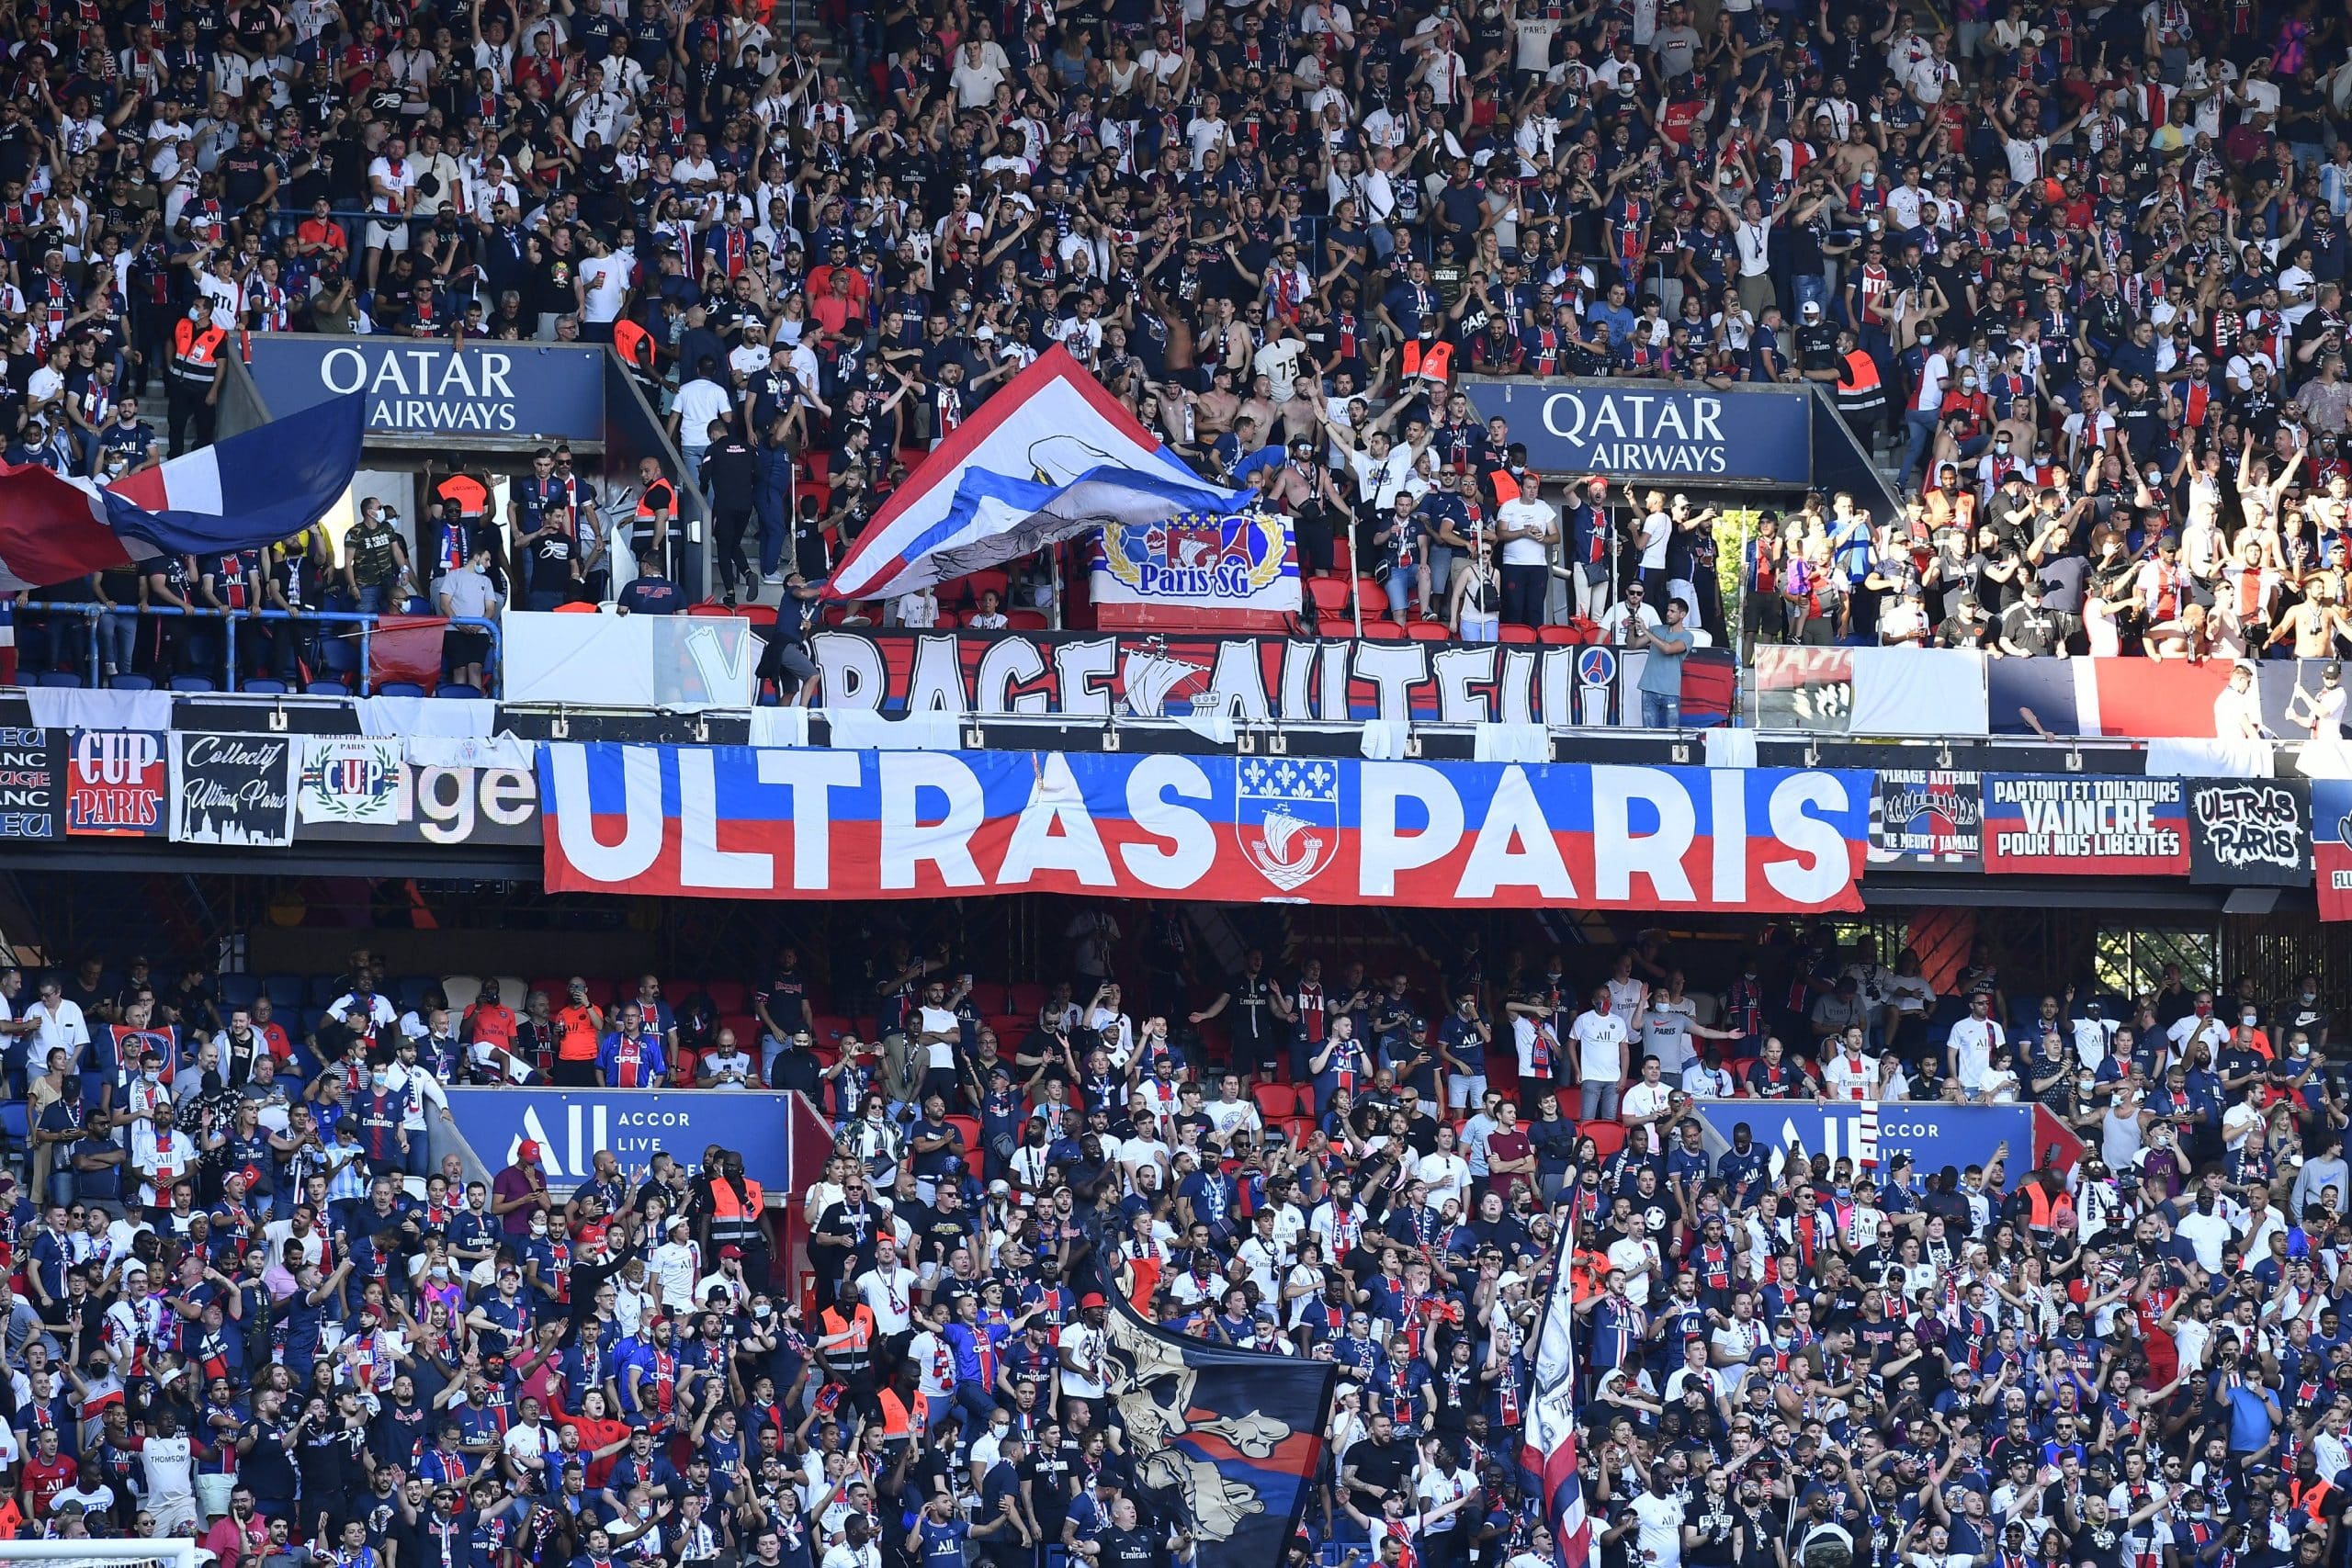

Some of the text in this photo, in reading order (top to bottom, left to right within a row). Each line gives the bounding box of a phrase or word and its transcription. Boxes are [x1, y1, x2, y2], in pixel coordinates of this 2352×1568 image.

[1524, 25, 1547, 35] PARIS
[212, 291, 233, 313] RTL
[321, 347, 515, 396] QATAR
[1276, 361, 1299, 380] 75
[370, 400, 517, 431] AIRWAYS
[1543, 392, 1725, 448] QATAR
[121, 441, 136, 451] All
[1589, 443, 1726, 474] AIRWAYS
[1388, 541, 1417, 549] Emates
[226, 573, 242, 585] All
[1138, 563, 1251, 597] Paris SG
[684, 624, 1117, 716] VRAGE
[0, 752, 47, 767] NC
[79, 730, 160, 784] CUP
[323, 760, 384, 795] CUP
[1881, 770, 1979, 785] VIRAGE AUTEUIL
[184, 779, 287, 813] Ultras Paris
[1994, 780, 2182, 805] PARTOUT ET TOUJOURS
[77, 788, 158, 826] PARIS
[2199, 790, 2296, 825] ULTRAS
[550, 742, 1851, 904] ULTRAS PARIS
[2021, 799, 2157, 835] VAINCRE
[1883, 833, 1979, 852] NE MEURT JAMAIS
[1997, 827, 2181, 858] POUR NOS LIBERTÉS
[2211, 828, 2296, 861] PARIS
[1239, 998, 1265, 1007] Emirates
[2300, 1011, 2317, 1020] NIKE
[644, 1021, 659, 1032] All
[1654, 1026, 1677, 1036] PARIS
[1463, 1034, 1477, 1045] All
[1596, 1031, 1610, 1041] All
[615, 1055, 643, 1065] OPEL
[2230, 1061, 2239, 1069] 32
[1842, 1078, 1870, 1088] Emirates
[1761, 1086, 1790, 1095] Emirates
[363, 1118, 394, 1128] Emirates
[618, 1111, 690, 1127] ACCOR
[618, 1138, 662, 1152] LIVE
[156, 1152, 173, 1164] All
[1875, 1148, 1913, 1162] IVE
[467, 1236, 494, 1247] Emirates
[974, 1345, 991, 1353] OPE
[650, 1371, 676, 1382] OPEL
[1017, 1372, 1050, 1382] Emirates
[488, 1391, 504, 1404] All
[150, 1454, 185, 1464] THOMSON
[48, 1479, 63, 1491] All
[1702, 1516, 1732, 1525] PARIS
[938, 1540, 953, 1551] All
